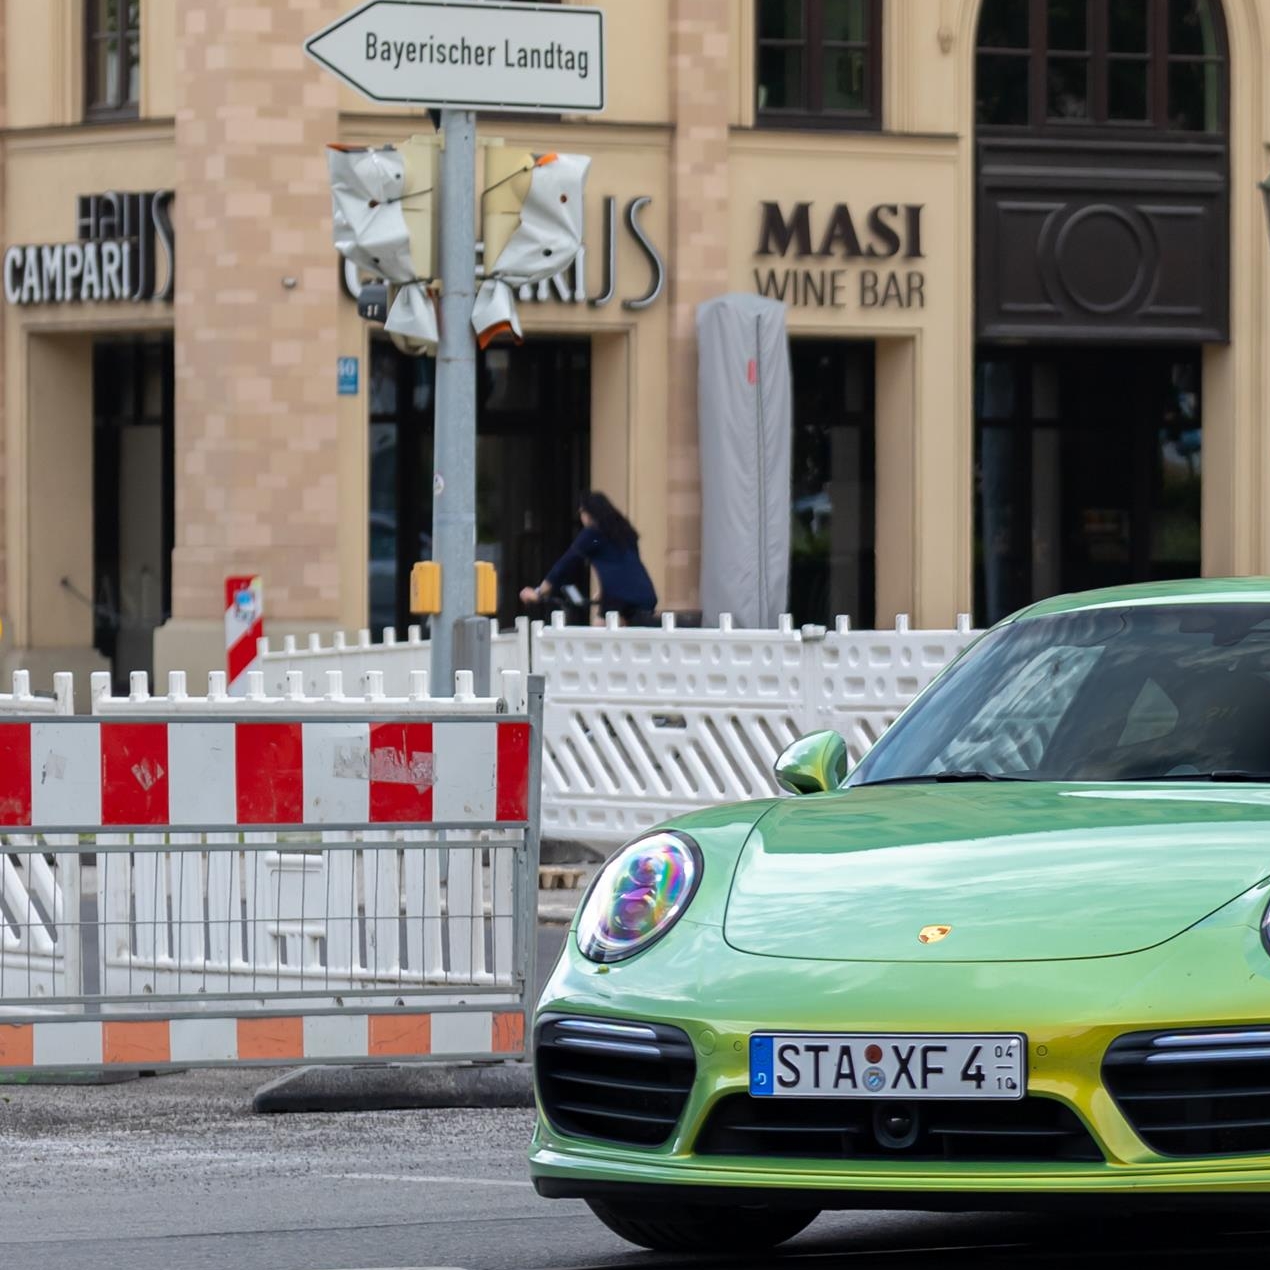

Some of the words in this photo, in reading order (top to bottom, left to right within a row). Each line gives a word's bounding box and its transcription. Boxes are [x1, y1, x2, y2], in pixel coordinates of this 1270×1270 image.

[365, 31, 496, 69] Bayerischer
[504, 38, 588, 78] Landtag
[754, 200, 926, 258] MASI
[4, 242, 131, 305] CAMPARI
[754, 268, 847, 306] WINE
[859, 269, 925, 307] BAR
[776, 1044, 858, 1089] STA
[891, 1045, 947, 1089] XF
[960, 1045, 986, 1089] 4
[994, 1045, 1014, 1058] 04
[996, 1076, 1015, 1090] 10
